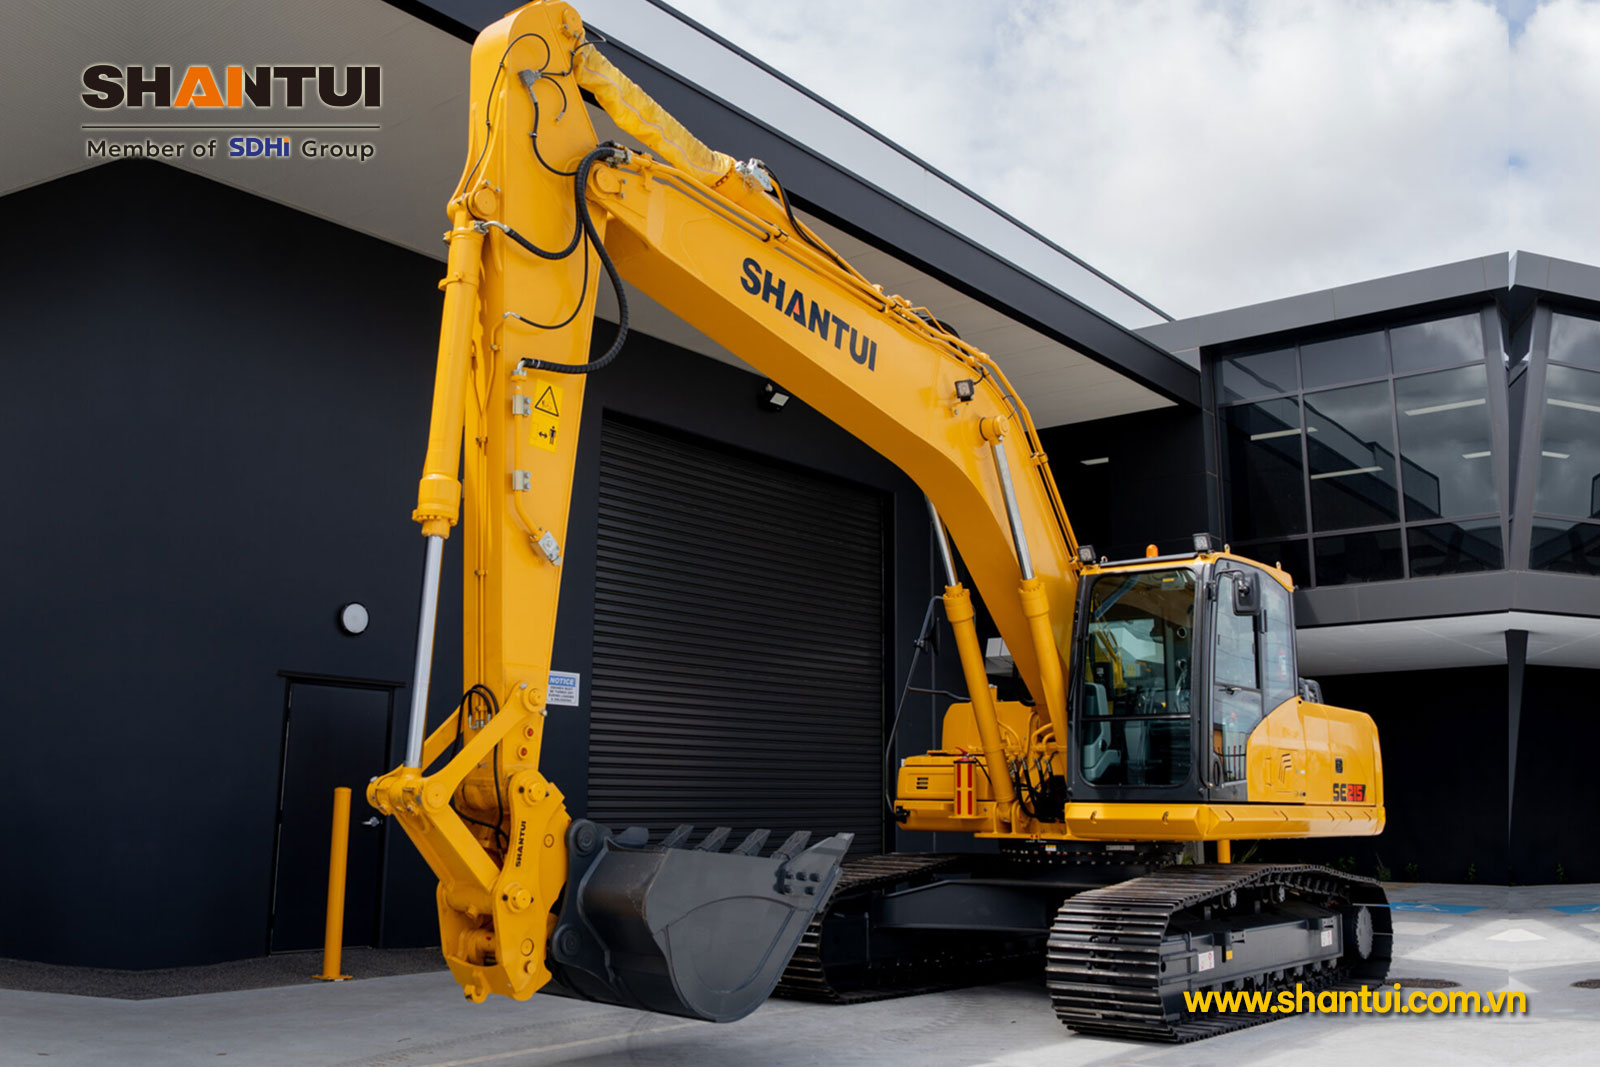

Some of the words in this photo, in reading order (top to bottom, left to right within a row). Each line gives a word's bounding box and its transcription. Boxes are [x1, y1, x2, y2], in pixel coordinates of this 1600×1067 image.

[740, 257, 877, 372] SHANTUI
[550, 677, 574, 685] NOTICE
[515, 820, 526, 867] SHANTUI
